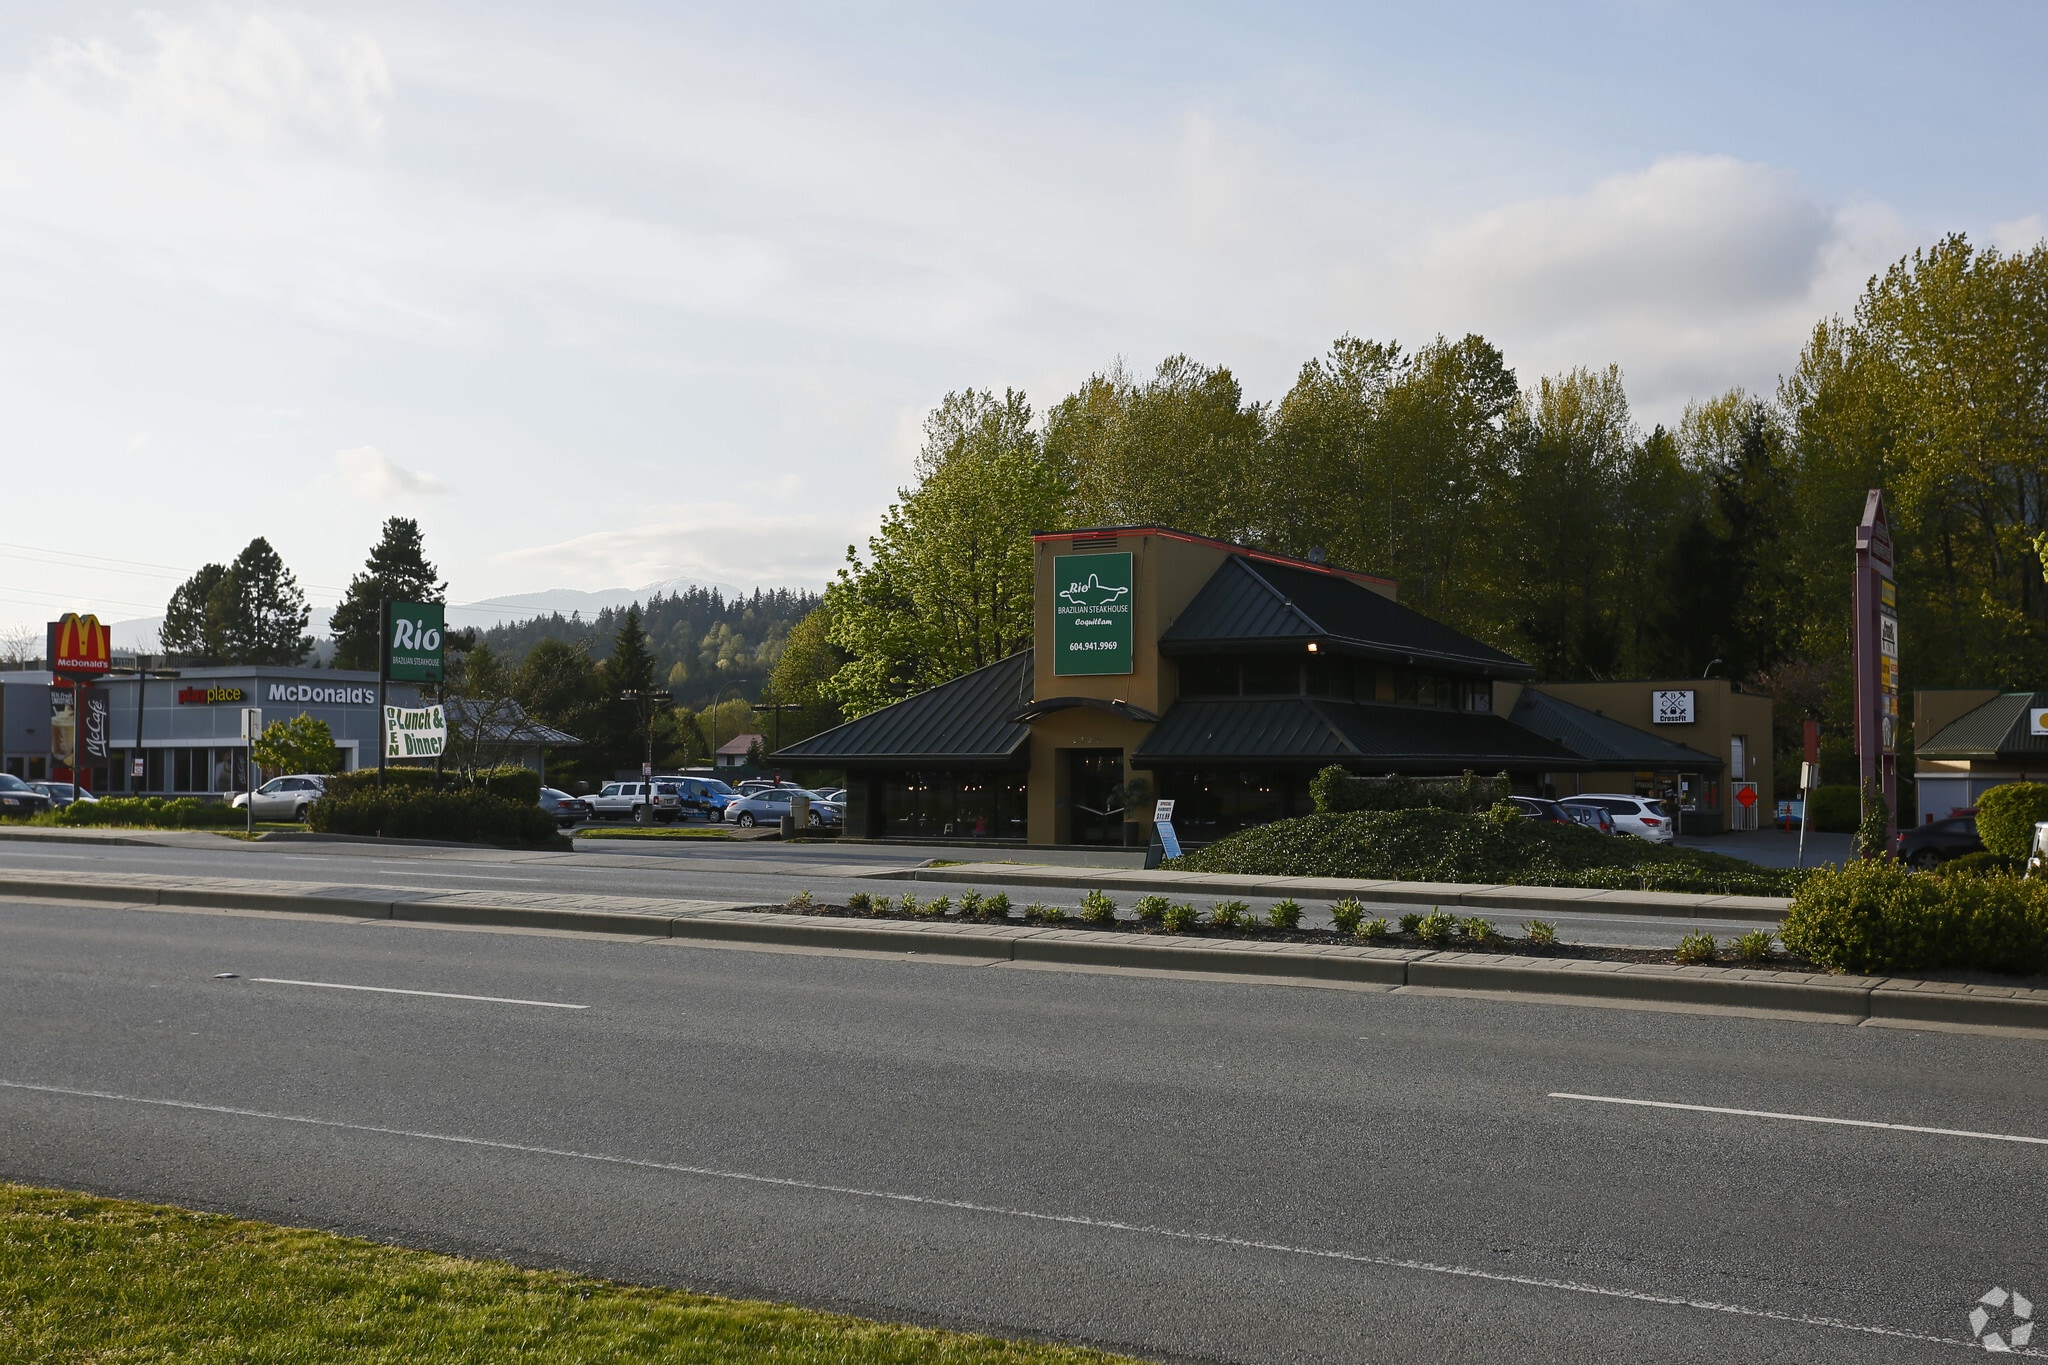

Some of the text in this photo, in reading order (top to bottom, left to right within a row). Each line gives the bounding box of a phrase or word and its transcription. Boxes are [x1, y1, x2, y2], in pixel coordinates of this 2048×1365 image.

[1070, 582, 1088, 593] Rio
[1057, 605, 1128, 614] BRAZILIAN STEAKHOUSE
[1075, 618, 1112, 627] Coquitlam
[392, 618, 441, 651] Rio
[1069, 641, 1117, 651] 604.941.9969
[57, 658, 108, 668] McDonald's
[392, 656, 440, 667] BRAZILIAN STEAKHOUSE
[268, 683, 375, 705] McDonald's
[396, 707, 444, 730] Lunch &
[86, 698, 107, 758] McCafé
[387, 708, 399, 755] OPEN
[405, 733, 443, 756] Dinner
